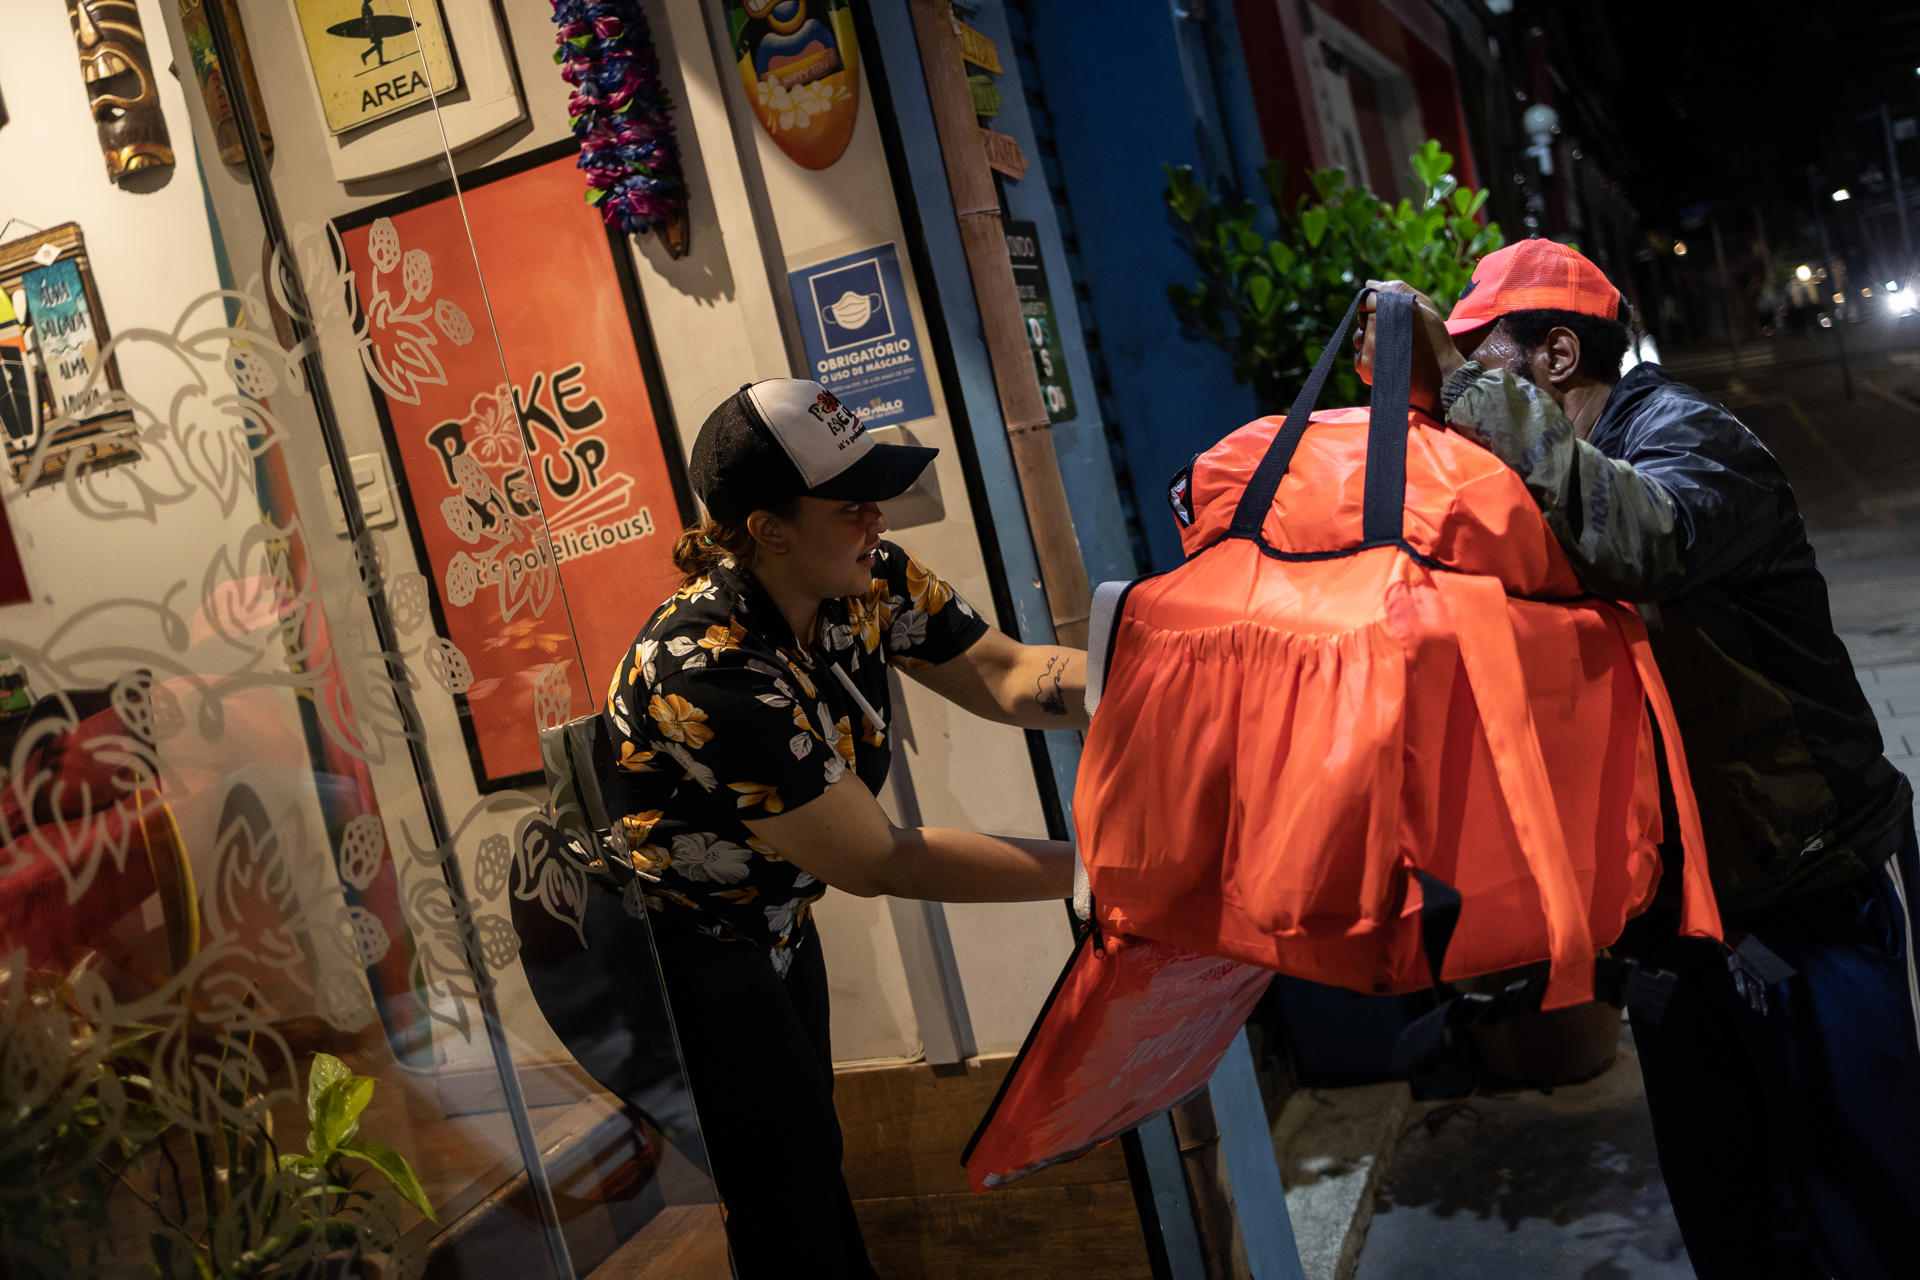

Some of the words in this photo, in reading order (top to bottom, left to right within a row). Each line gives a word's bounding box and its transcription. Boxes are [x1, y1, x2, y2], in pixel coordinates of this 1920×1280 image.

[361, 70, 428, 112] AREA
[60, 357, 89, 380] ALMA
[817, 338, 911, 373] OBRIGATÓRIO
[820, 375, 829, 384] O
[830, 370, 851, 382] USO
[852, 366, 863, 376] DE
[865, 354, 914, 372] MÁSCARA.
[427, 363, 606, 487] PKE
[544, 439, 606, 497] UP
